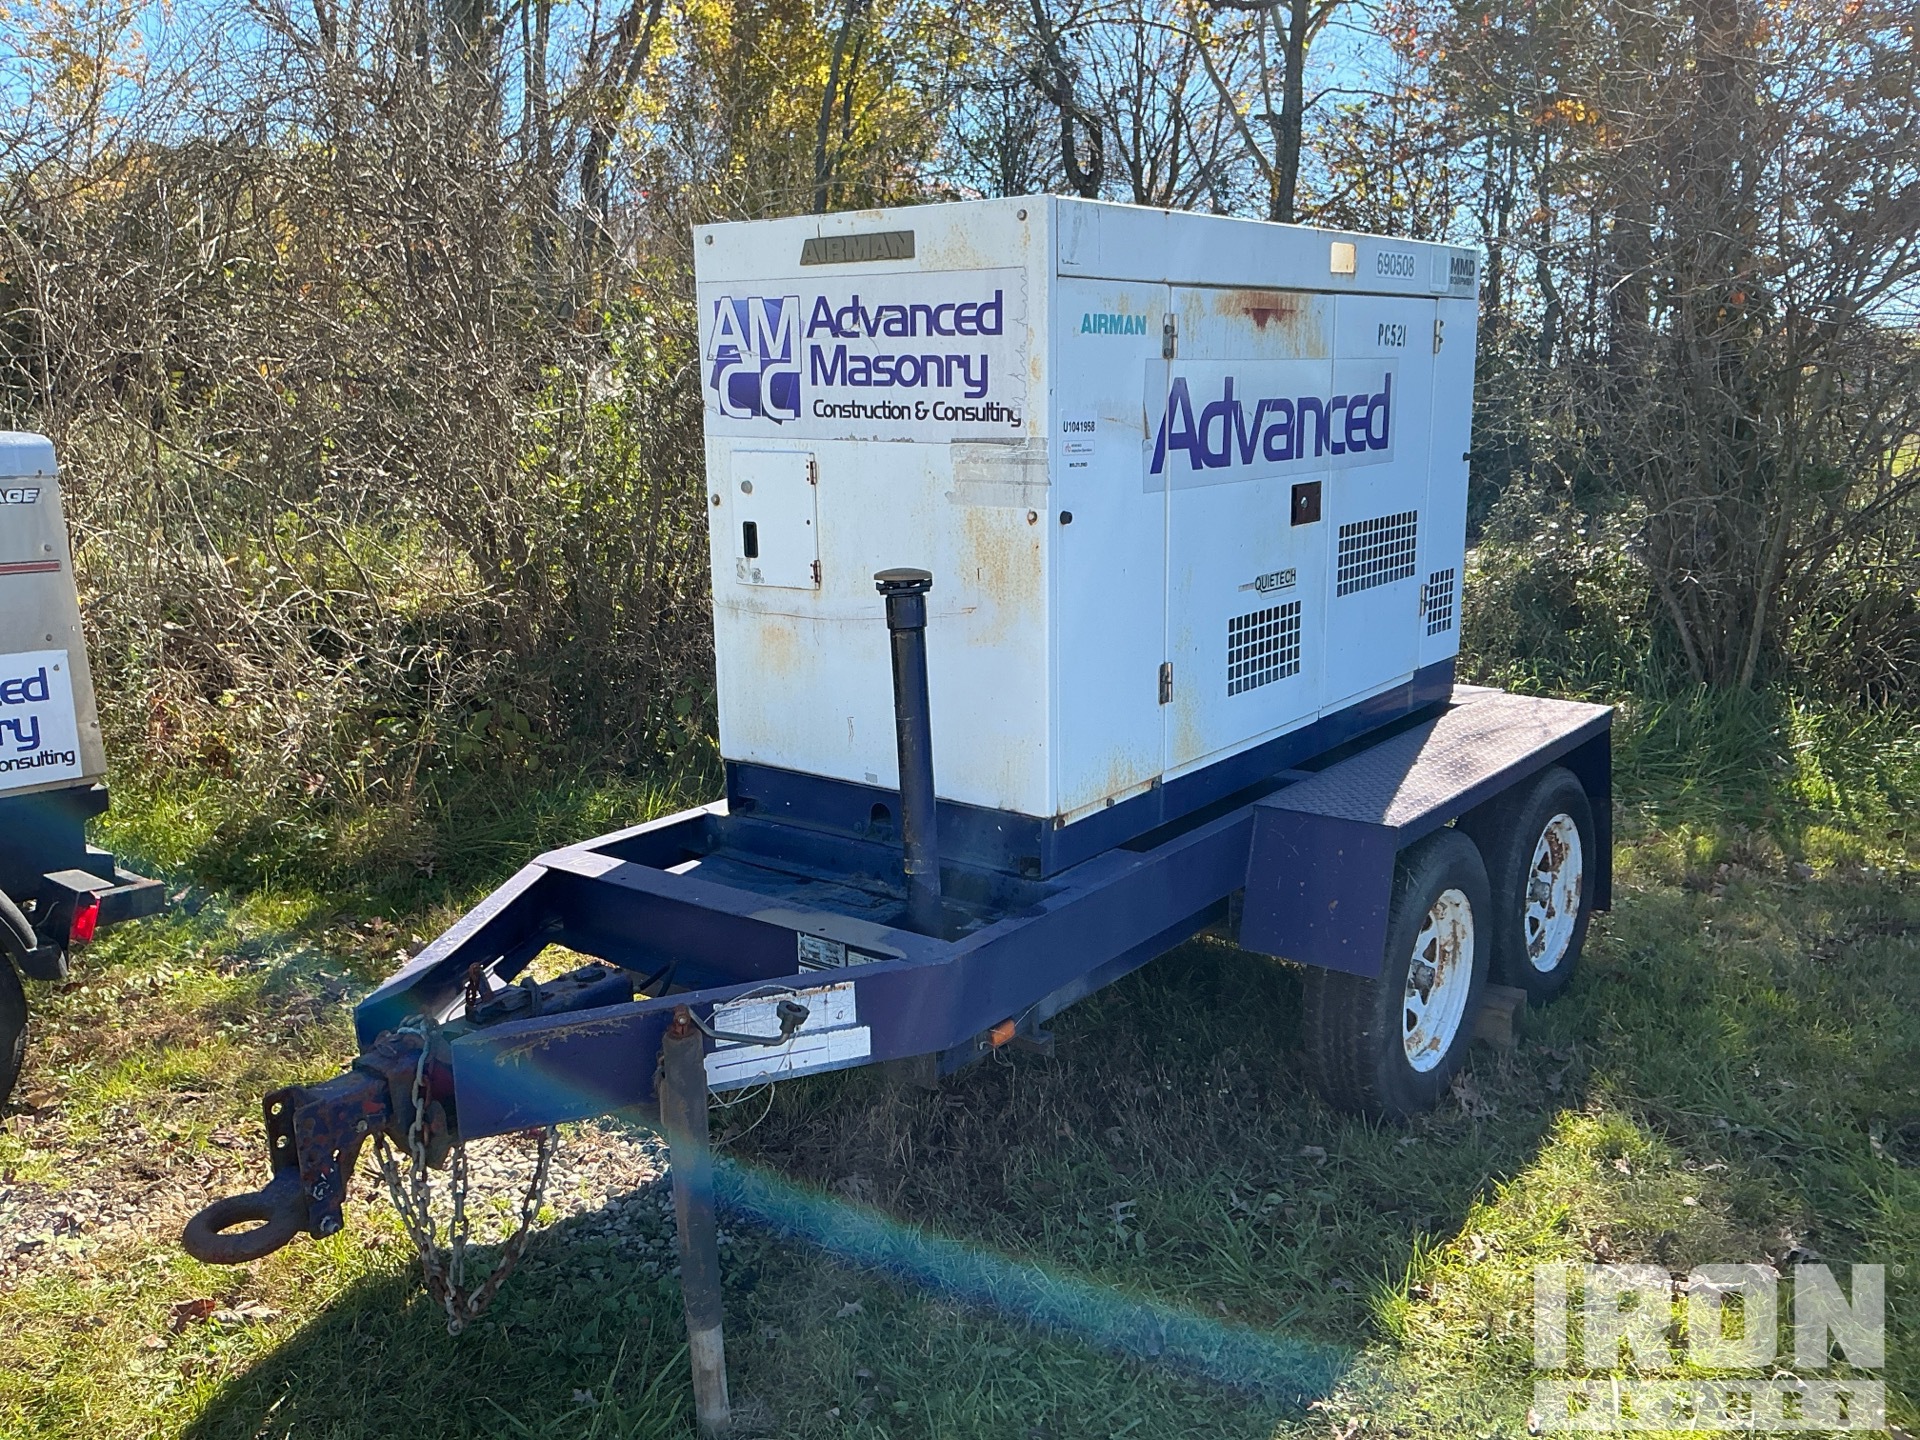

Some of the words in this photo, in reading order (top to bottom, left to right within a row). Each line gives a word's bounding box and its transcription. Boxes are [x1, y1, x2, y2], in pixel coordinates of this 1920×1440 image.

[800, 230, 914, 265] AIRMAN
[1377, 252, 1415, 277] 690508
[1450, 257, 1475, 276] MMD
[806, 289, 1003, 338] Advanced
[1080, 313, 1147, 335] AIRMAN
[1377, 323, 1407, 347] PC521
[810, 345, 989, 398] Masonry
[813, 399, 911, 419] Construction
[915, 401, 930, 420] &
[933, 401, 1022, 427] Consulting
[1149, 372, 1392, 475] Advanced
[1063, 421, 1096, 432] U1041958
[1255, 569, 1297, 590] QUIETECH
